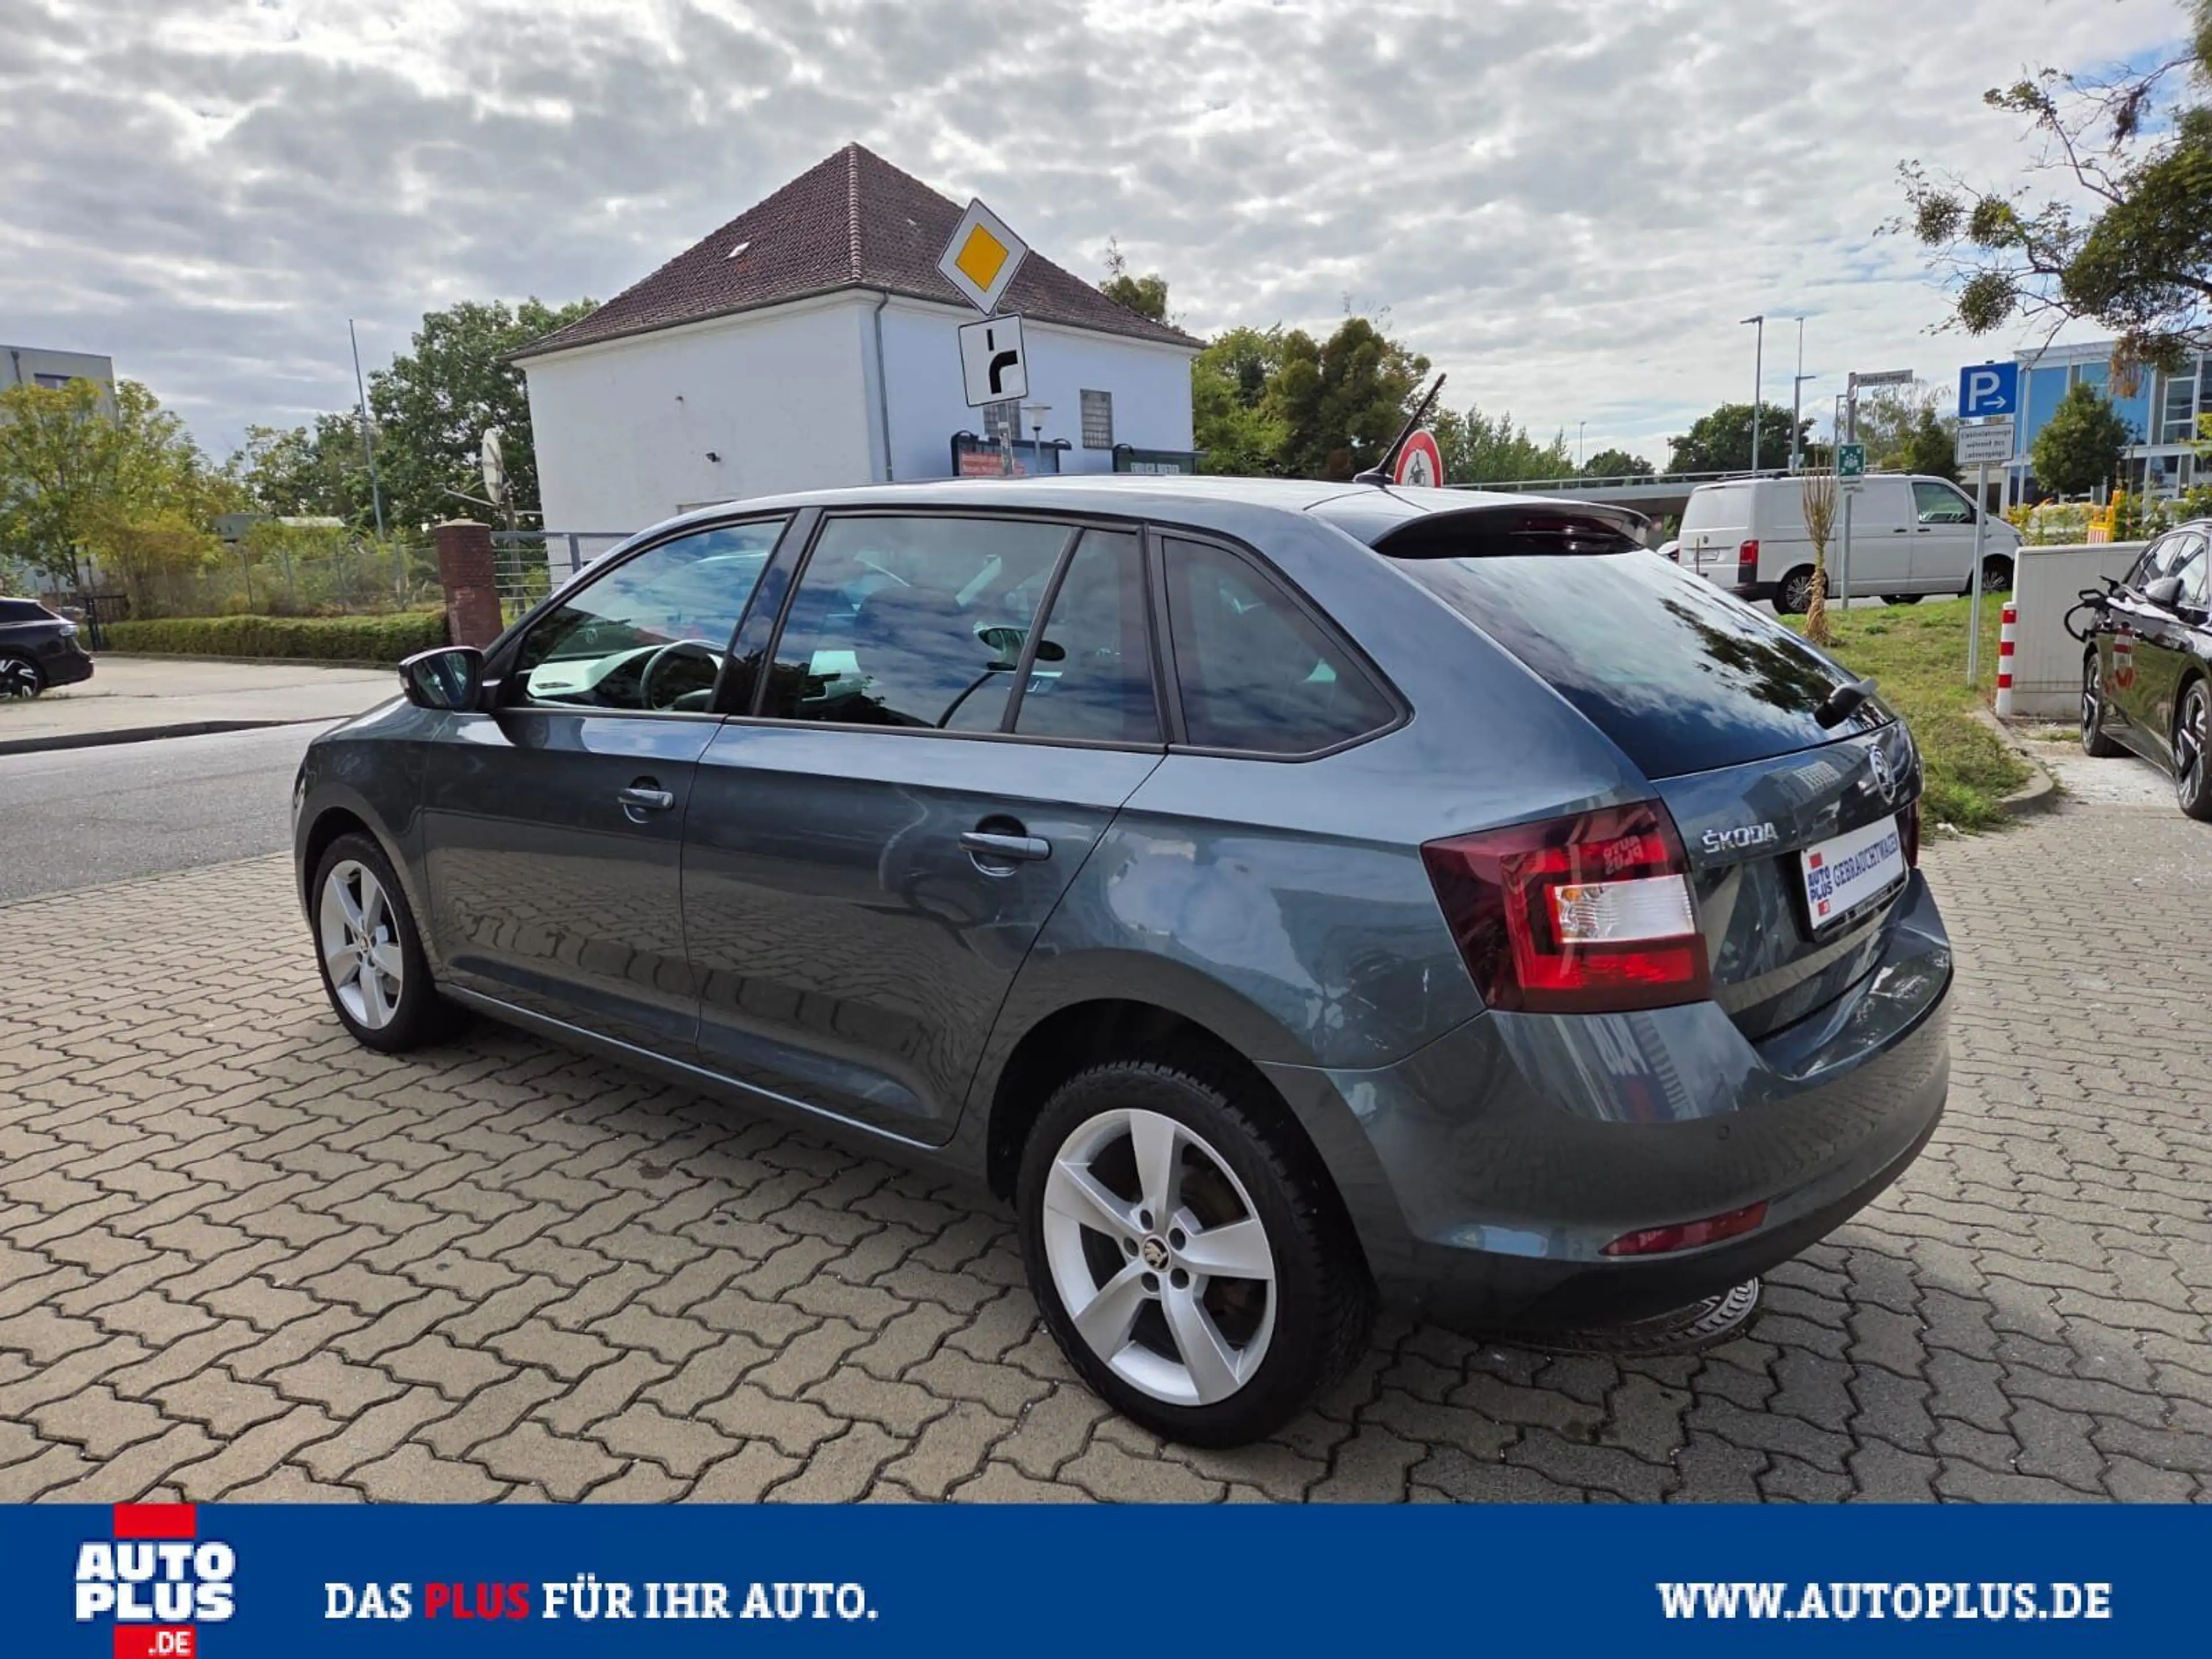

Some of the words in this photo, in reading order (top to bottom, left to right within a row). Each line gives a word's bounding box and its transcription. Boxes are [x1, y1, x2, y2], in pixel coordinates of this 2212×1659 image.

[1968, 372, 2001, 411] P
[1702, 822, 1778, 853] ŠKODA
[1808, 865, 1830, 887] AUTO
[1810, 881, 1833, 903] PLUS
